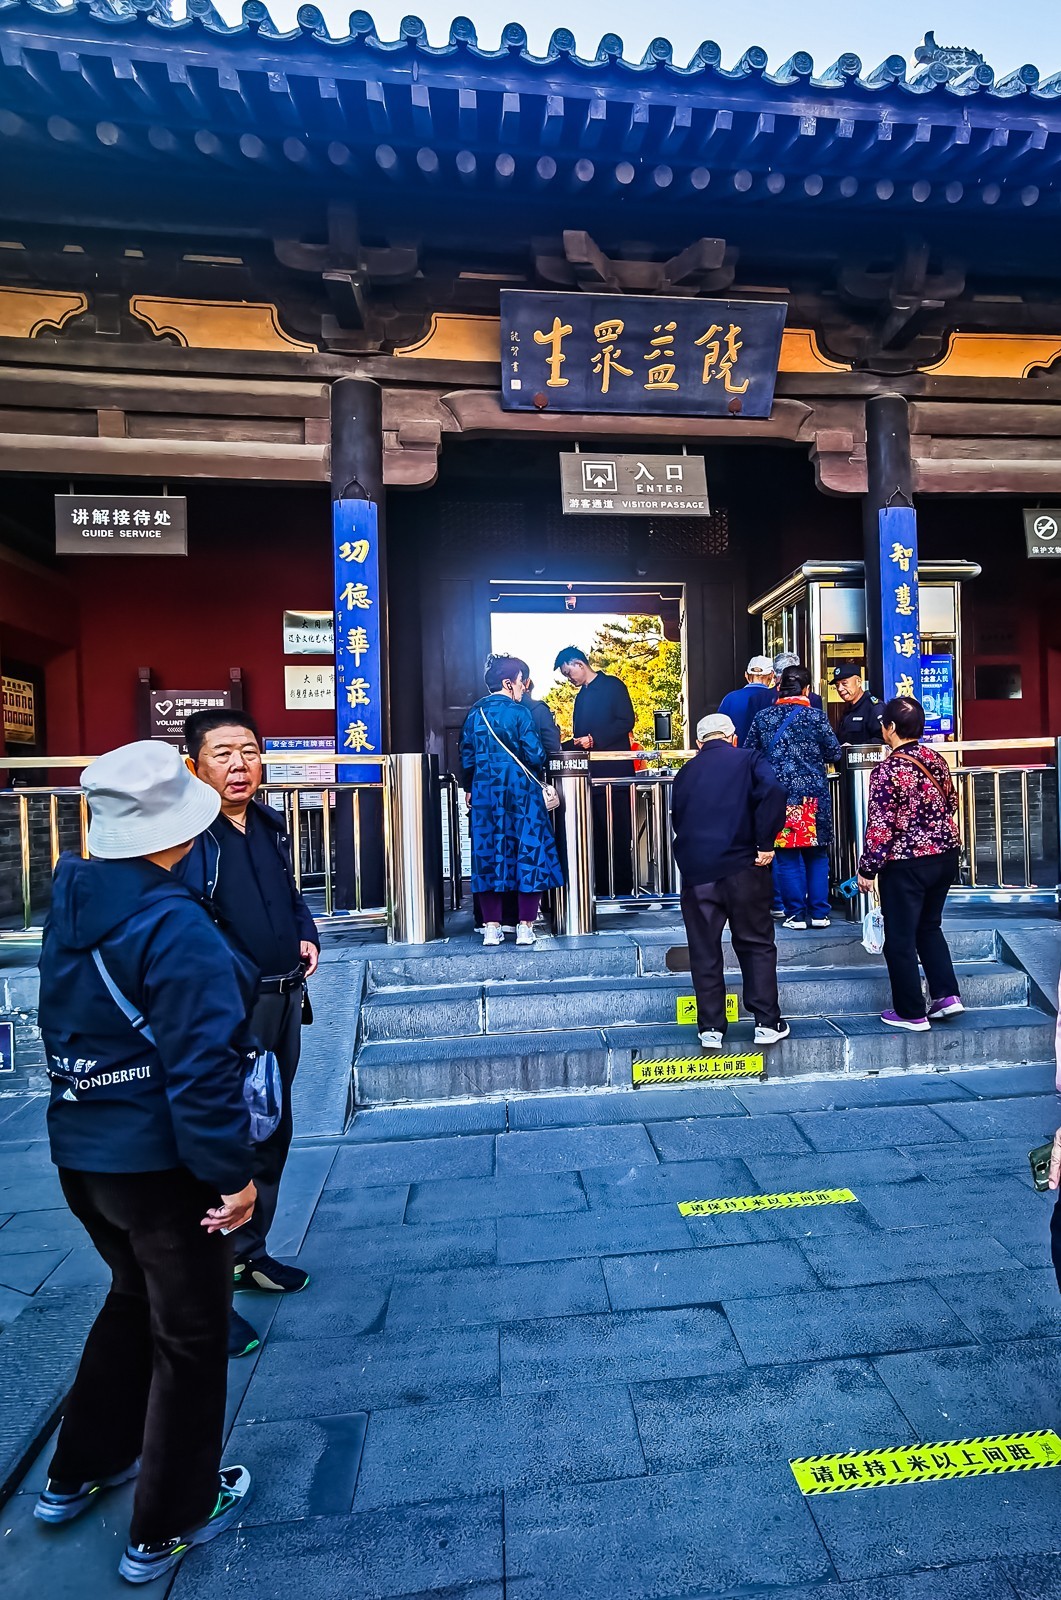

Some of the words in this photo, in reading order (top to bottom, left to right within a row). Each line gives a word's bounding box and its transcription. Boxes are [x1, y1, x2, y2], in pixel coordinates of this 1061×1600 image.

[634, 462, 683, 480] 入口
[636, 484, 683, 493] ENTER
[569, 499, 614, 509] 游客通道
[622, 500, 658, 509] VISITOR
[660, 501, 705, 509] PASSAGE
[71, 508, 172, 526] 讲解接待处
[82, 529, 114, 538] GUIDE
[119, 530, 162, 538] SERVICE
[272, 740, 335, 748] 安全生产挂牌责任
[641, 1060, 746, 1077] 请保持1米以上间距
[690, 1193, 832, 1212] 请保持1米以上间距
[810, 1443, 1035, 1484] 请保持1米以上间距
